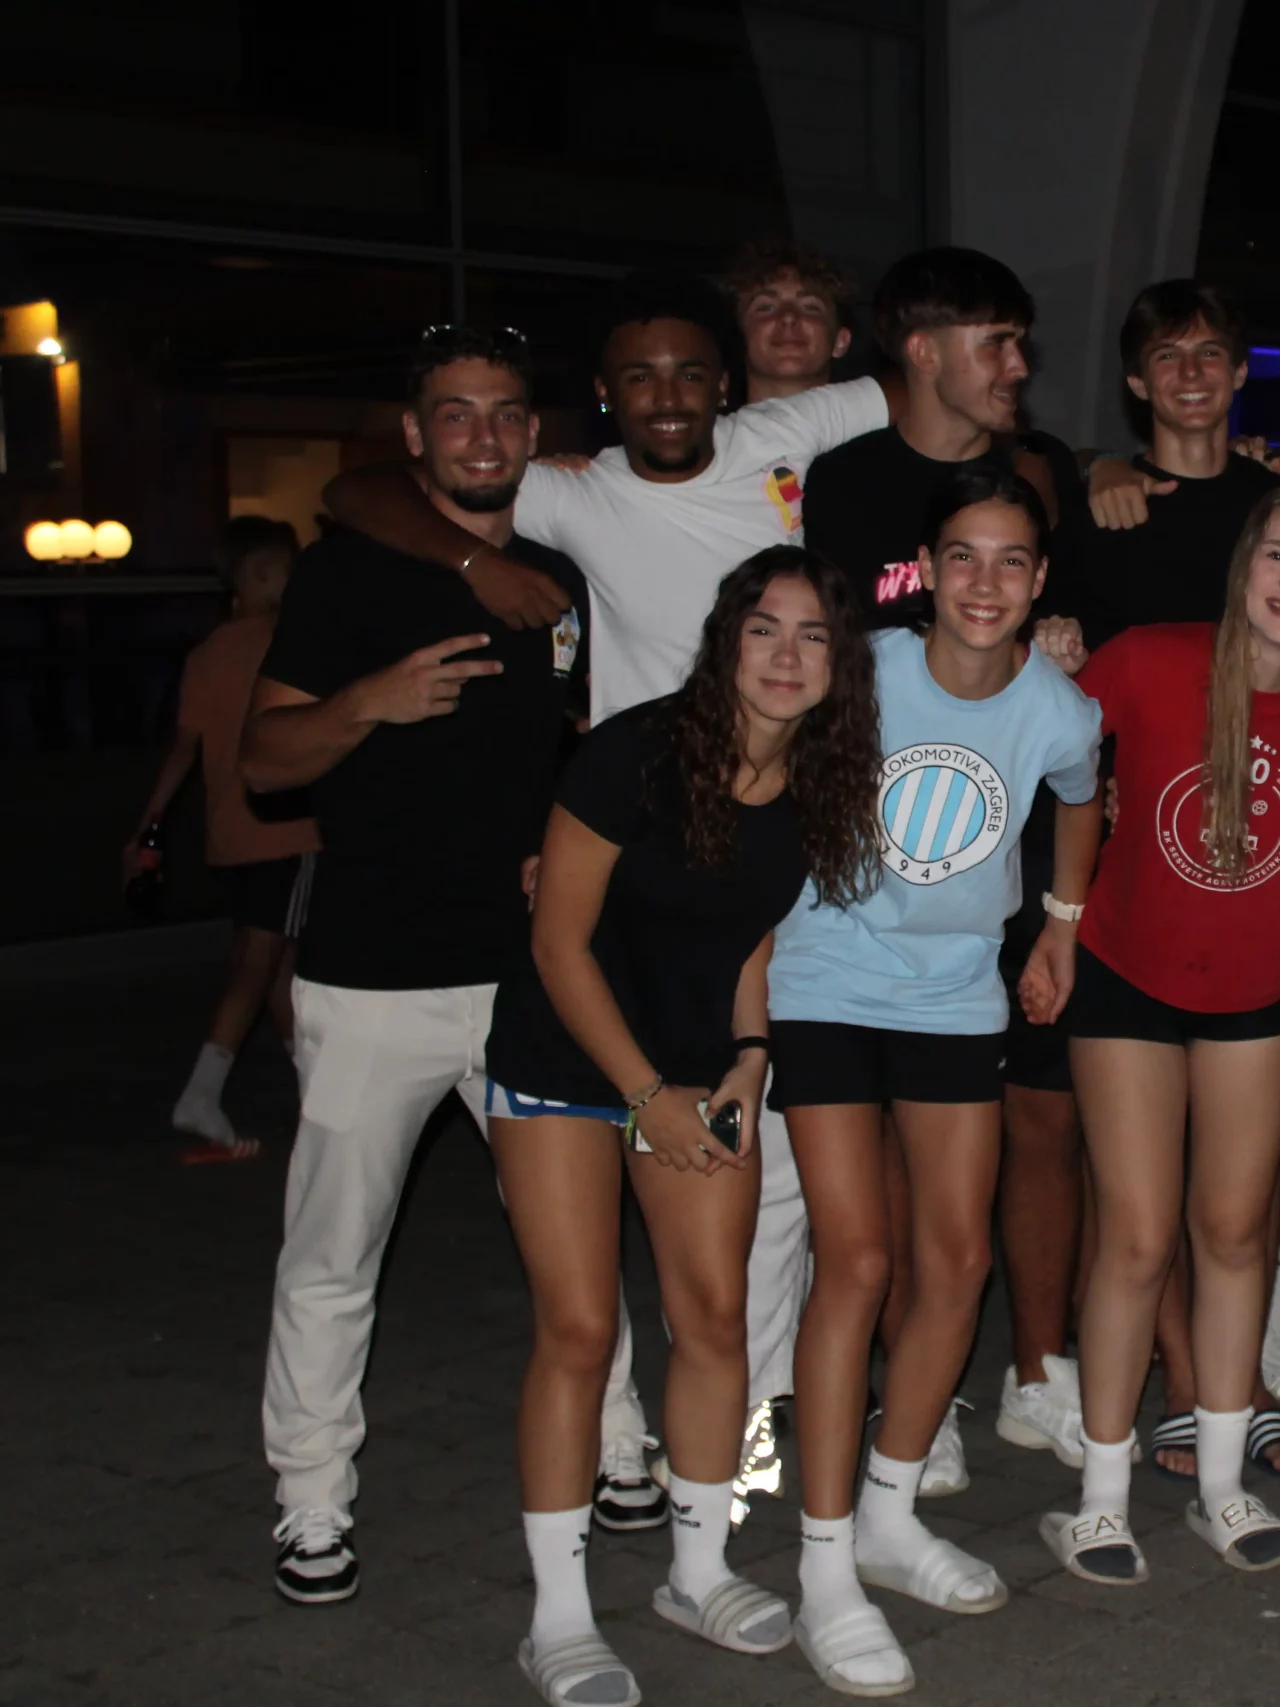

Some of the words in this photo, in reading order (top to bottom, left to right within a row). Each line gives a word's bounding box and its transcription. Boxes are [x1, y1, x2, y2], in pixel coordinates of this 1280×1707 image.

[883, 748, 981, 779] LOKOMOTIVA
[981, 774, 1003, 833] ZAGREB
[1169, 846, 1204, 880] SESVETE
